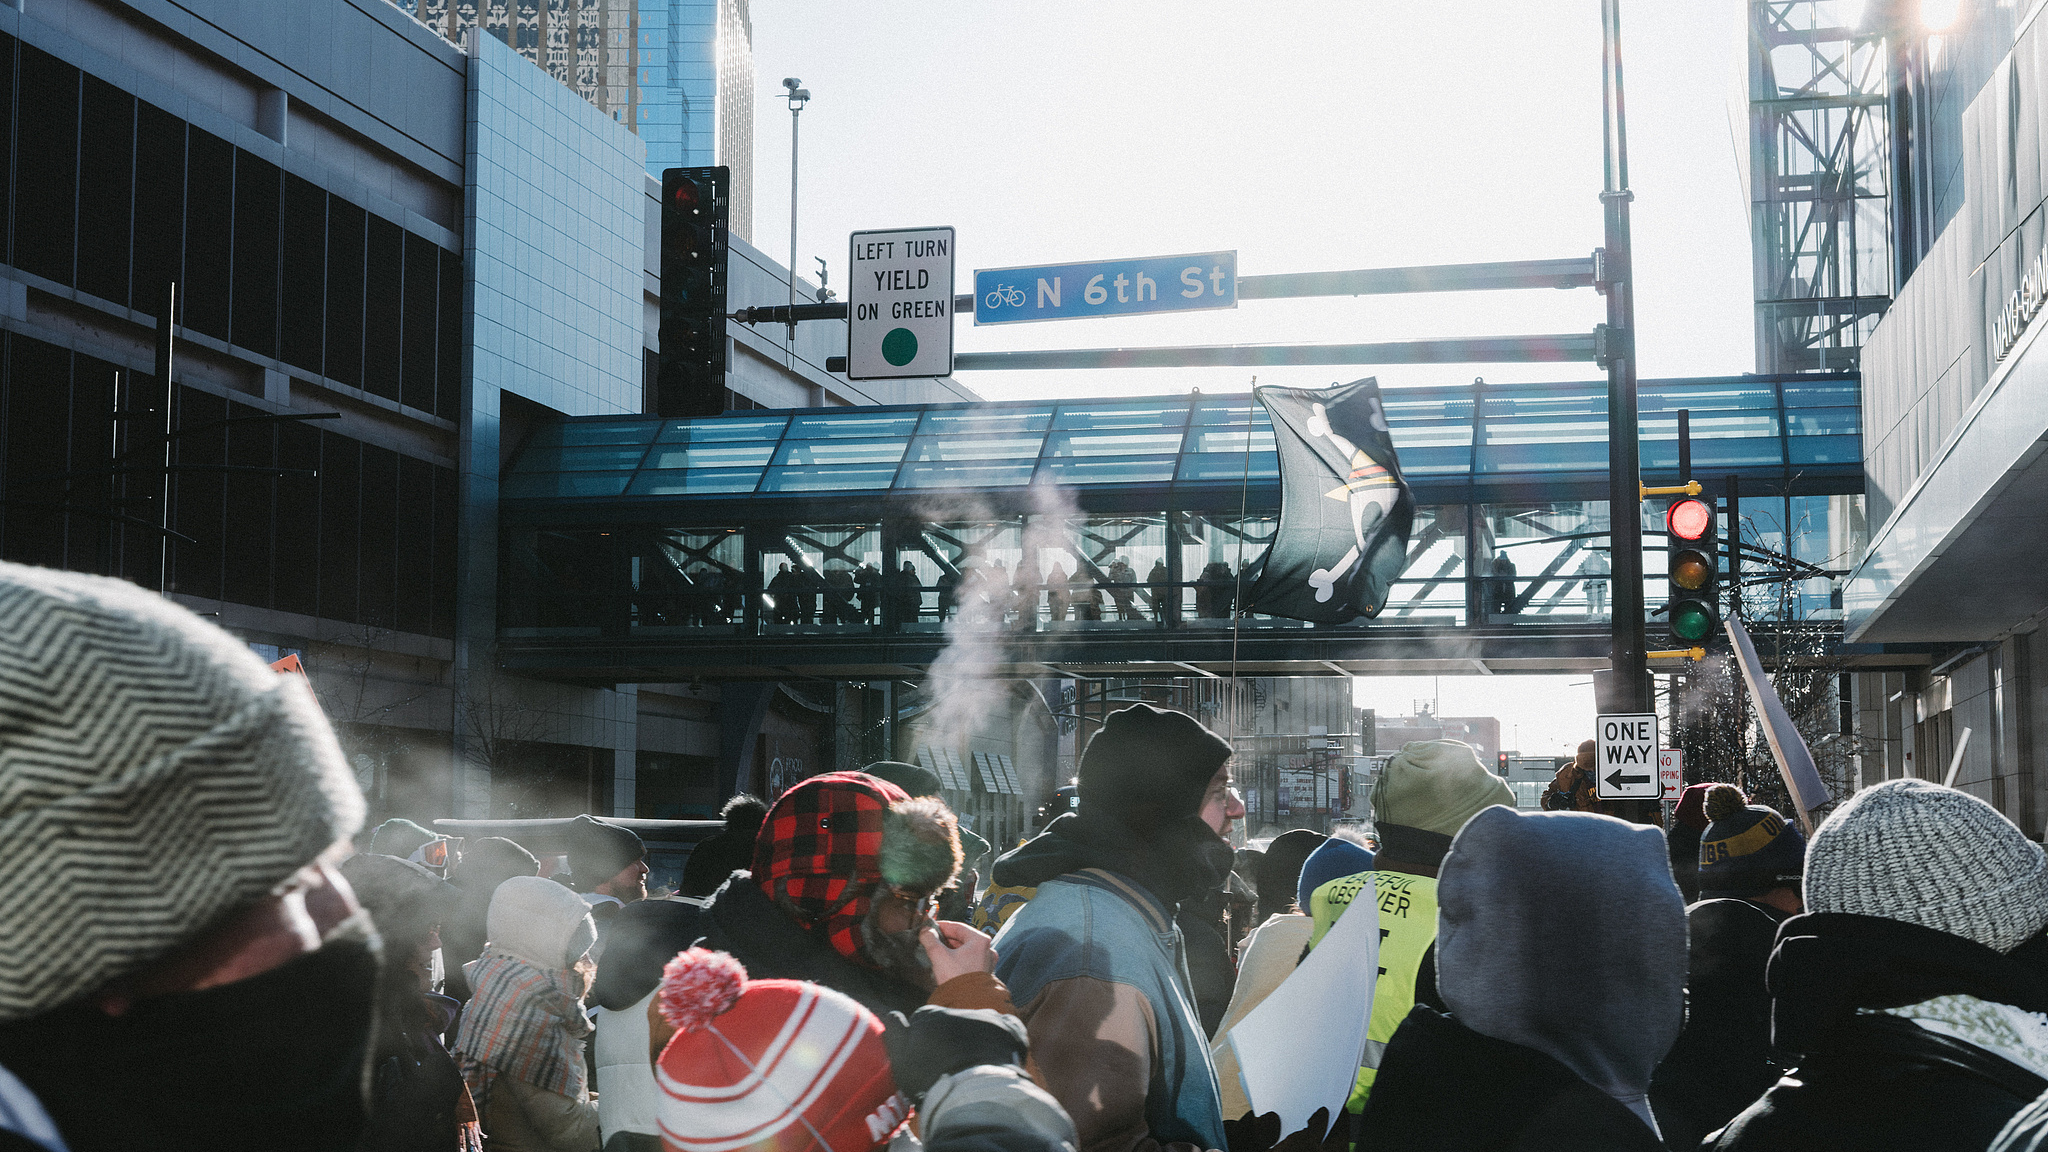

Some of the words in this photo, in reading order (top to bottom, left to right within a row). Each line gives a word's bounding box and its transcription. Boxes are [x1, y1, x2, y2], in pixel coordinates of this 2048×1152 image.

[857, 242, 894, 261] LEFT
[905, 239, 947, 258] TURN
[874, 269, 929, 291] YIELD
[1036, 277, 1062, 309] N
[1084, 272, 1157, 306] 6th
[1180, 266, 1226, 299] St
[857, 303, 879, 321] ON
[892, 299, 945, 319] GREEN
[1993, 290, 2018, 362] MAYO
[1605, 722, 1650, 741] ONE
[1606, 745, 1652, 764] WAY
[1660, 771, 1680, 780] PPING
